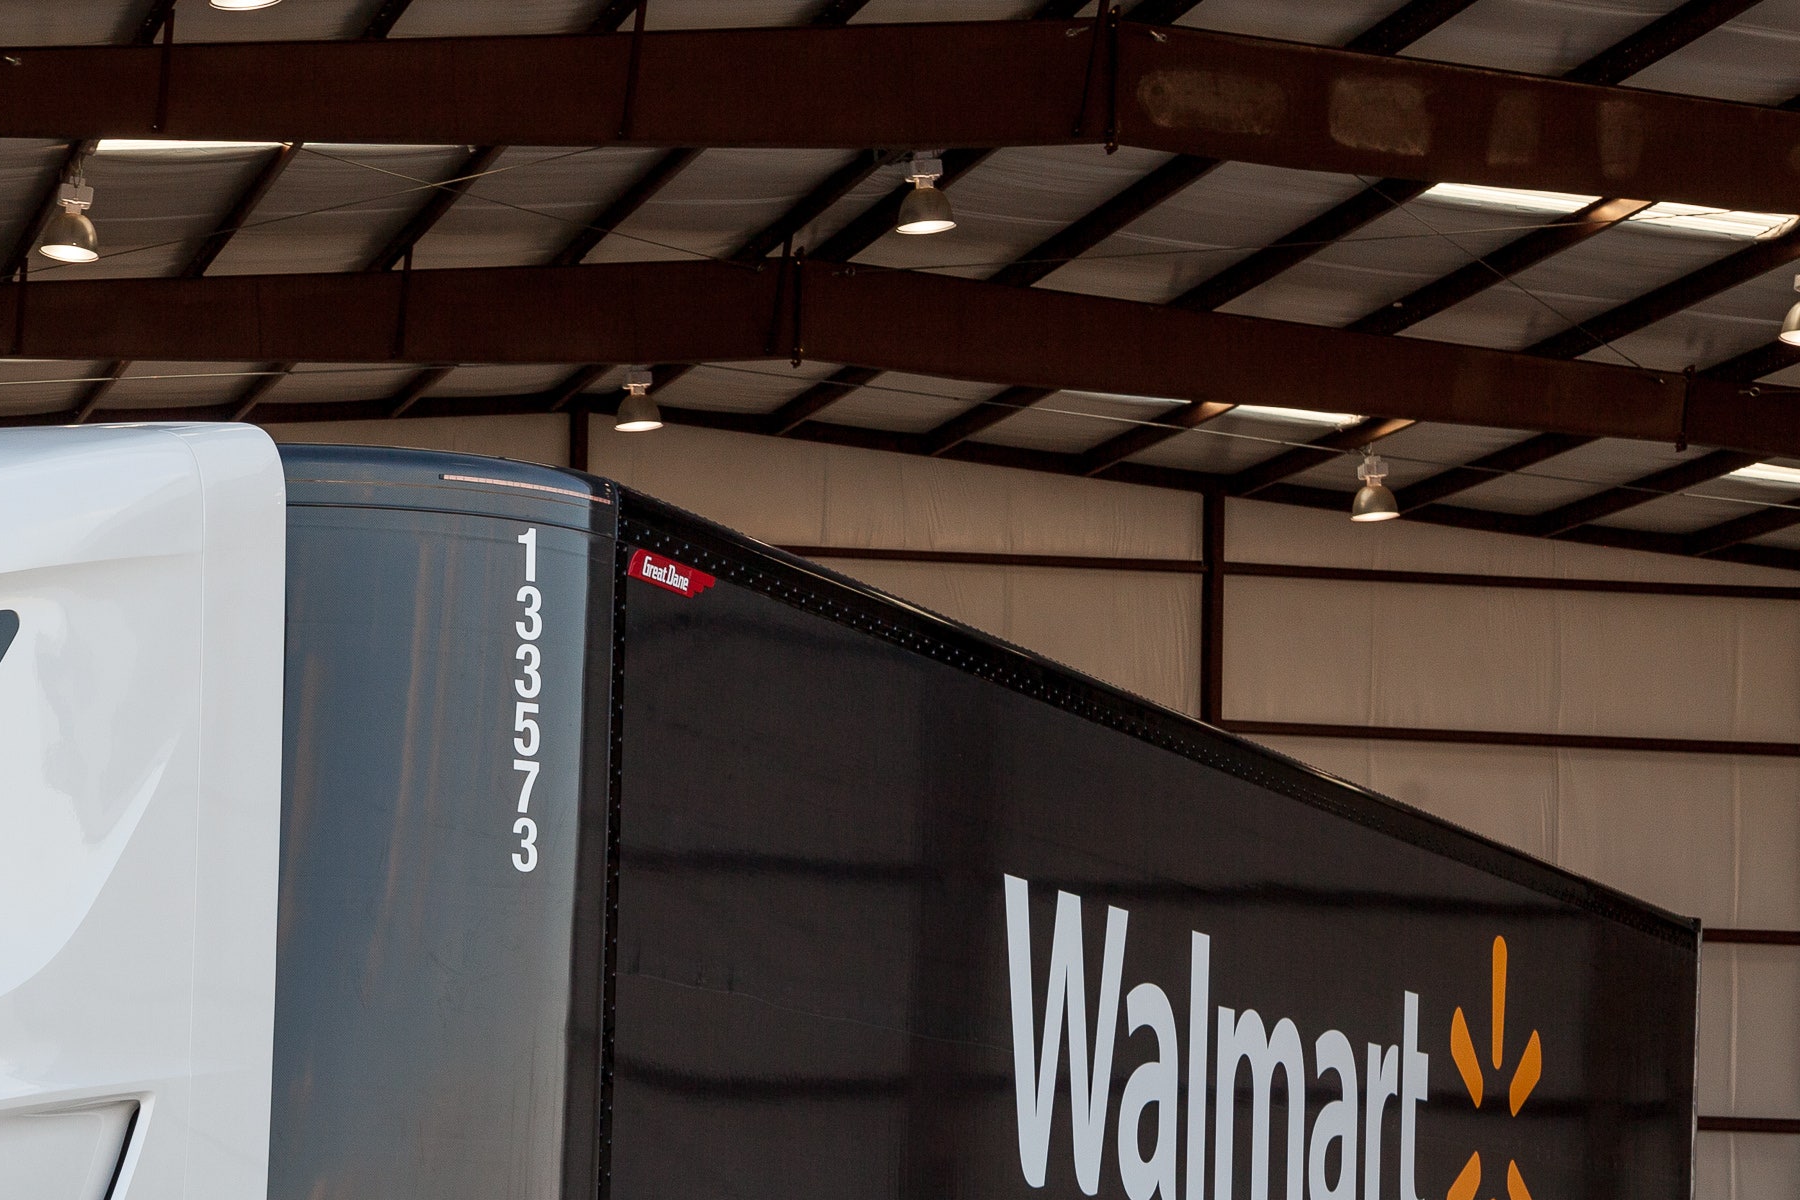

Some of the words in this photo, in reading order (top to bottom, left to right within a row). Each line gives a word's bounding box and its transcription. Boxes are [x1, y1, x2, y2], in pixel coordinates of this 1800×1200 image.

[641, 555, 668, 584] Great
[665, 564, 690, 592] Dane
[511, 527, 543, 873] 133573
